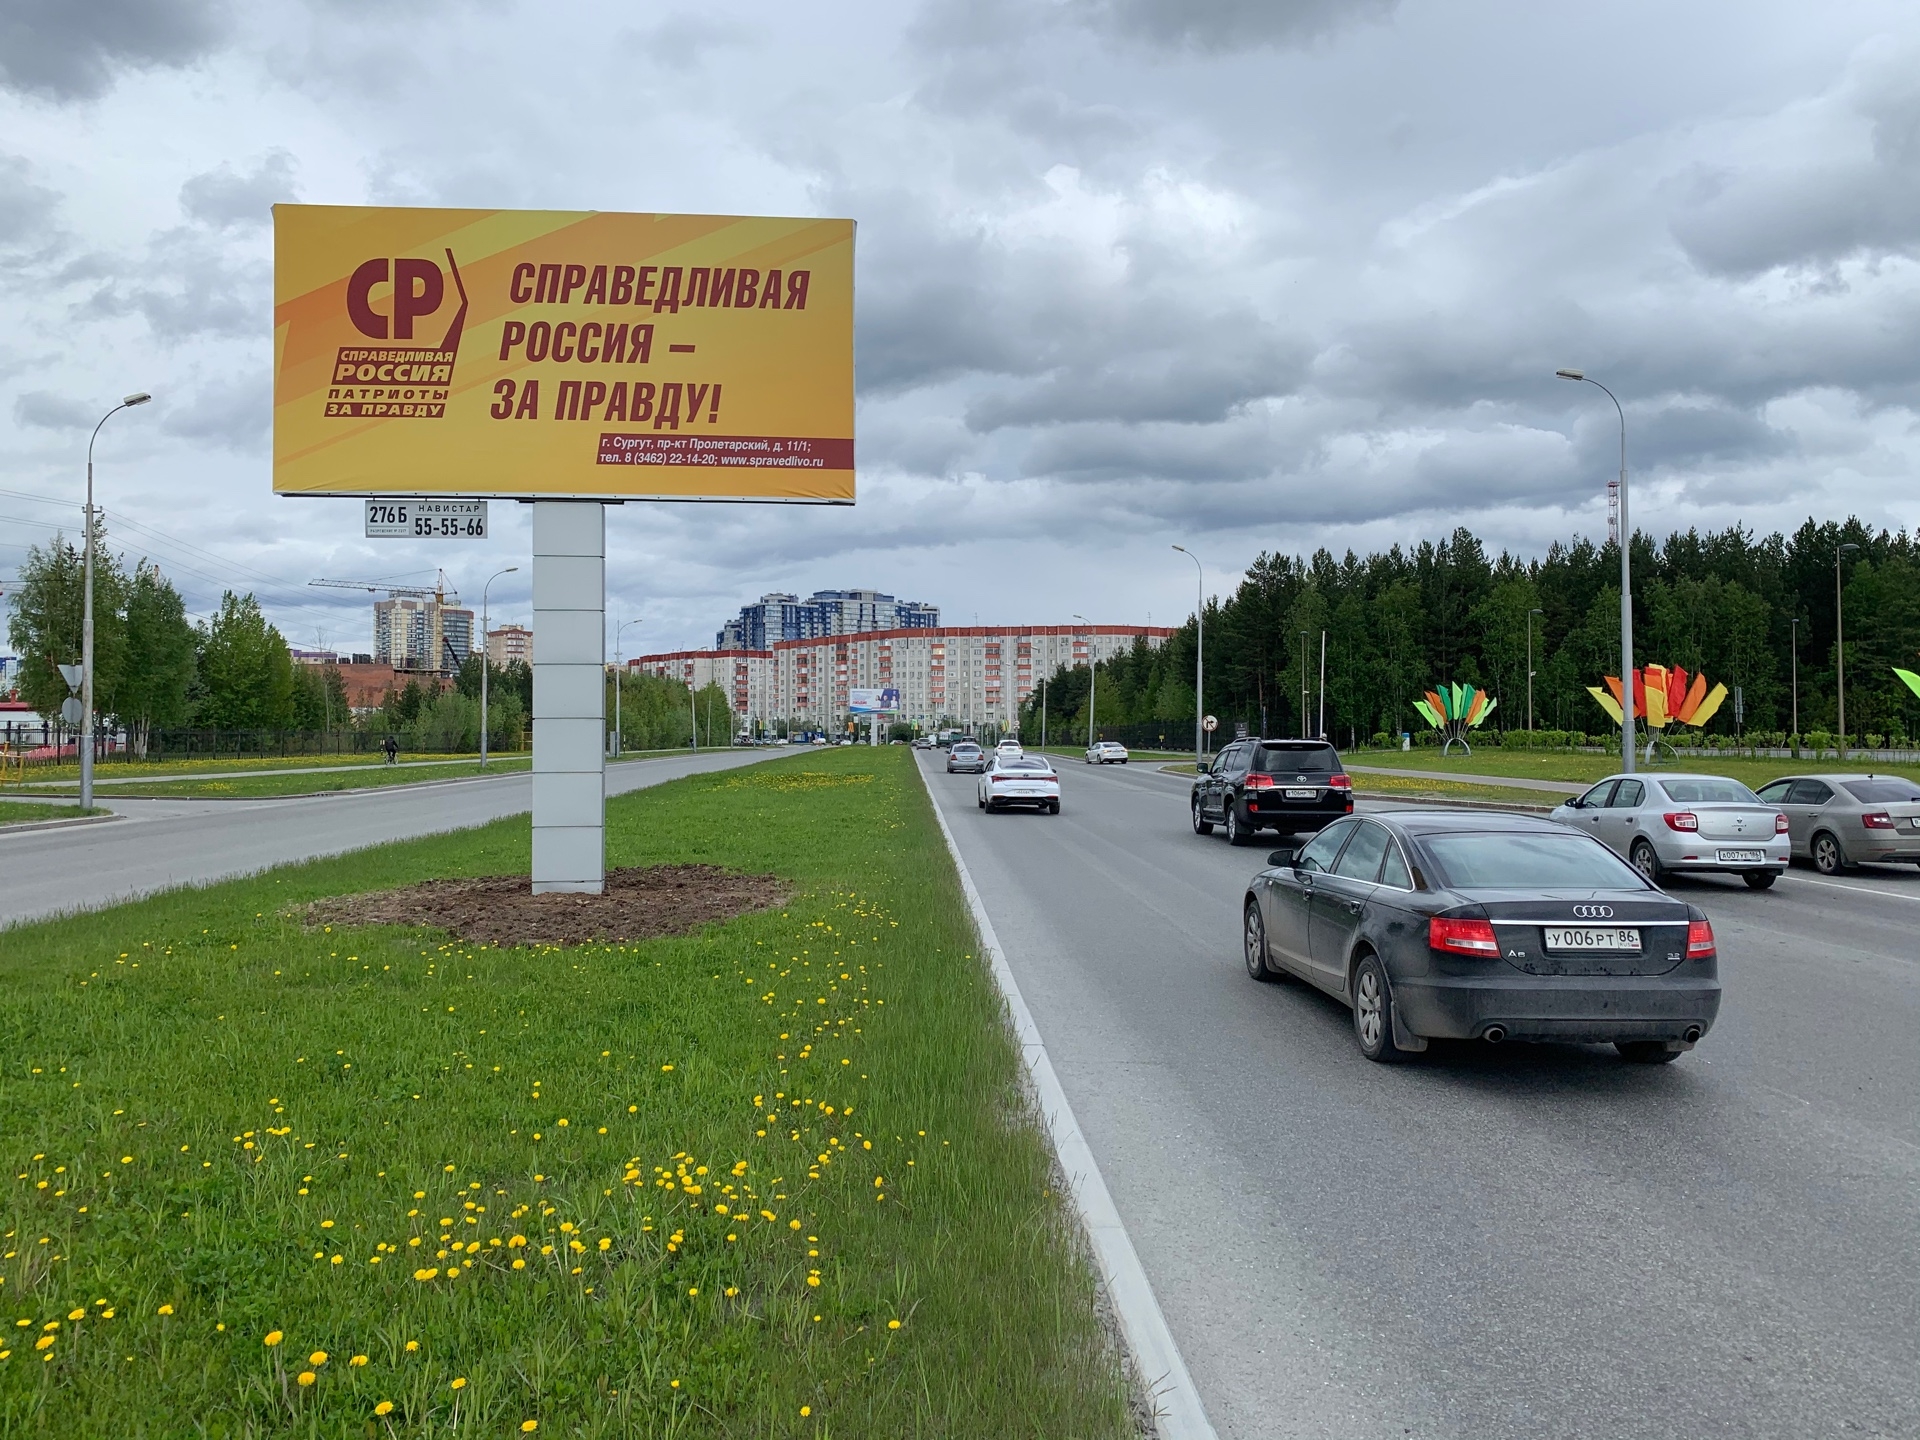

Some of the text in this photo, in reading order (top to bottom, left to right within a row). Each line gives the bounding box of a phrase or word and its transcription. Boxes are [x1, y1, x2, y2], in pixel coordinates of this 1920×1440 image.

[509, 262, 811, 314] СПРАВЕДЛИВАЯ
[346, 258, 444, 340] СР
[499, 320, 655, 364] РОССИЯ
[340, 350, 455, 363] СПРАВЕДЛИВАЯ
[335, 363, 451, 382] РОССИЯ
[328, 388, 449, 400] ПАТРИОТЫ
[327, 403, 442, 417] ЗА ПРАВДУ
[490, 378, 722, 430] ЗА ПРАВДУ!
[602, 436, 811, 453] г. Сургут, пр-кт Пролетарский, д. 11/1;
[600, 452, 824, 468] тел. 8 (3462) 22-14-20; www.spravedlivo.ru
[418, 504, 480, 513] НАВИСТАР
[415, 517, 484, 536] 55-55-66
[1619, 930, 1634, 943] 86
